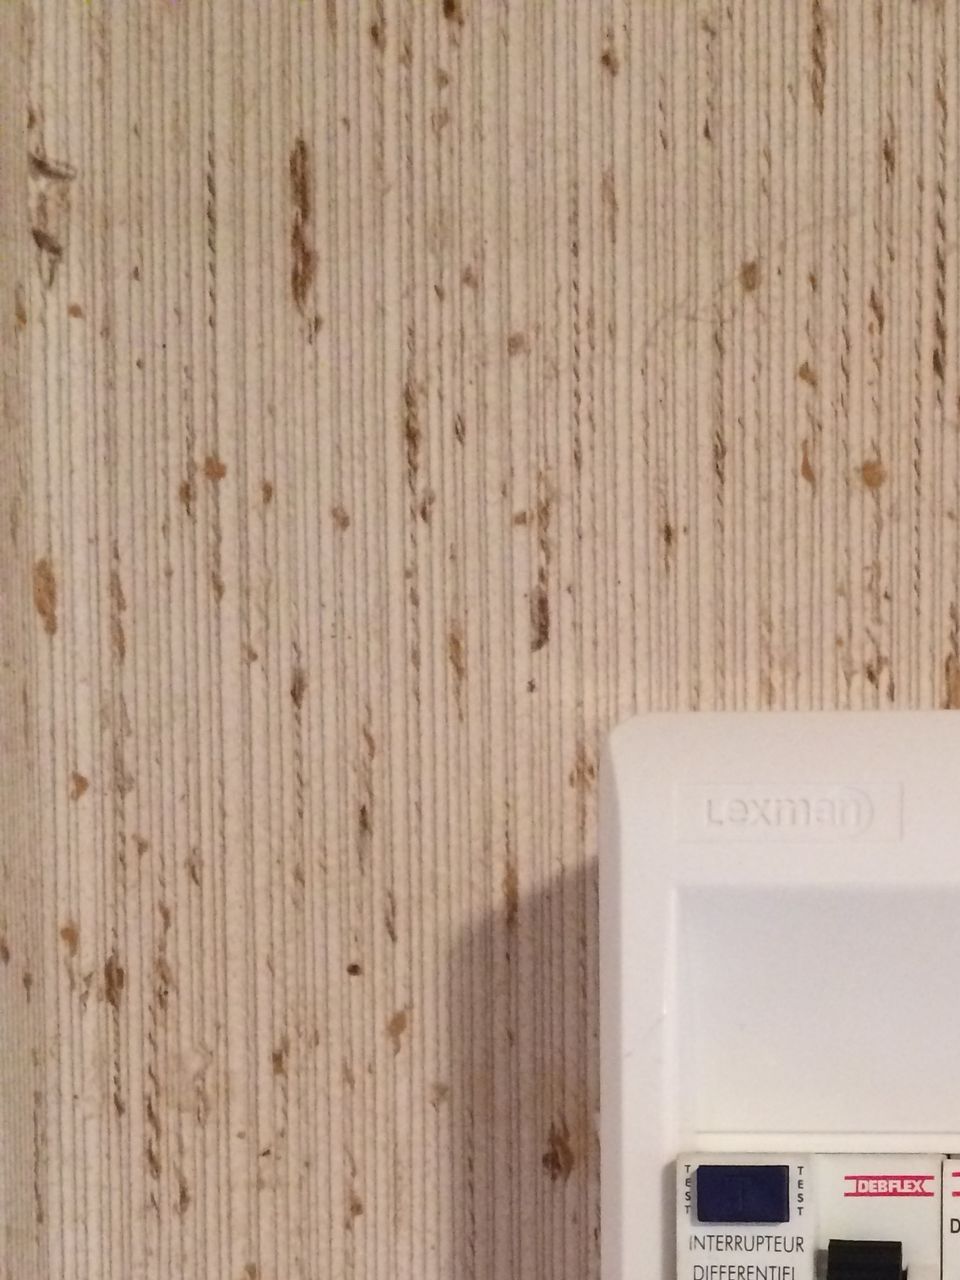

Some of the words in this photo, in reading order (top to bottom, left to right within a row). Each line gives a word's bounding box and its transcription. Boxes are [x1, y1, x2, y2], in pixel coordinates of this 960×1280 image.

[684, 1164, 692, 1215] TEST
[857, 1179, 926, 1194] DEBFLEX
[689, 1234, 805, 1253] INTERRUPTEUR
